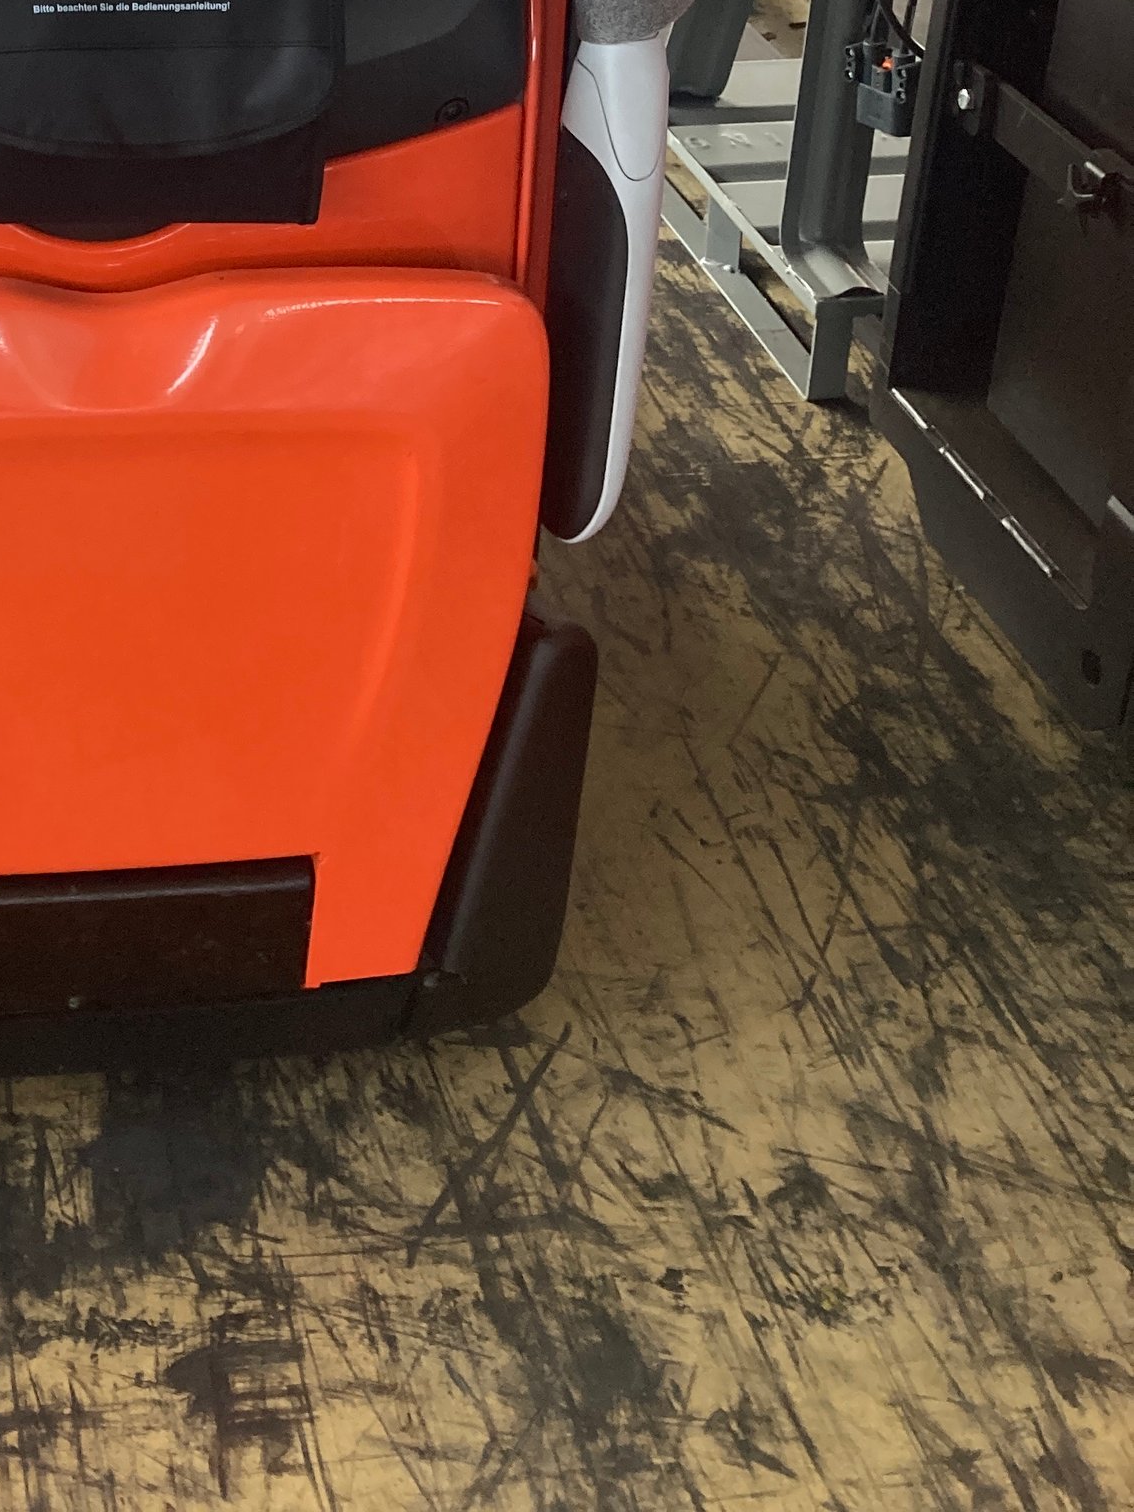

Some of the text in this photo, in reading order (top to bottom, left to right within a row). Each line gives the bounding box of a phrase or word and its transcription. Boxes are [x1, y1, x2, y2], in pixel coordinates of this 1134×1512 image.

[33, 1, 231, 14] Bitte beachten Sie die Bedienungsanleitung!
